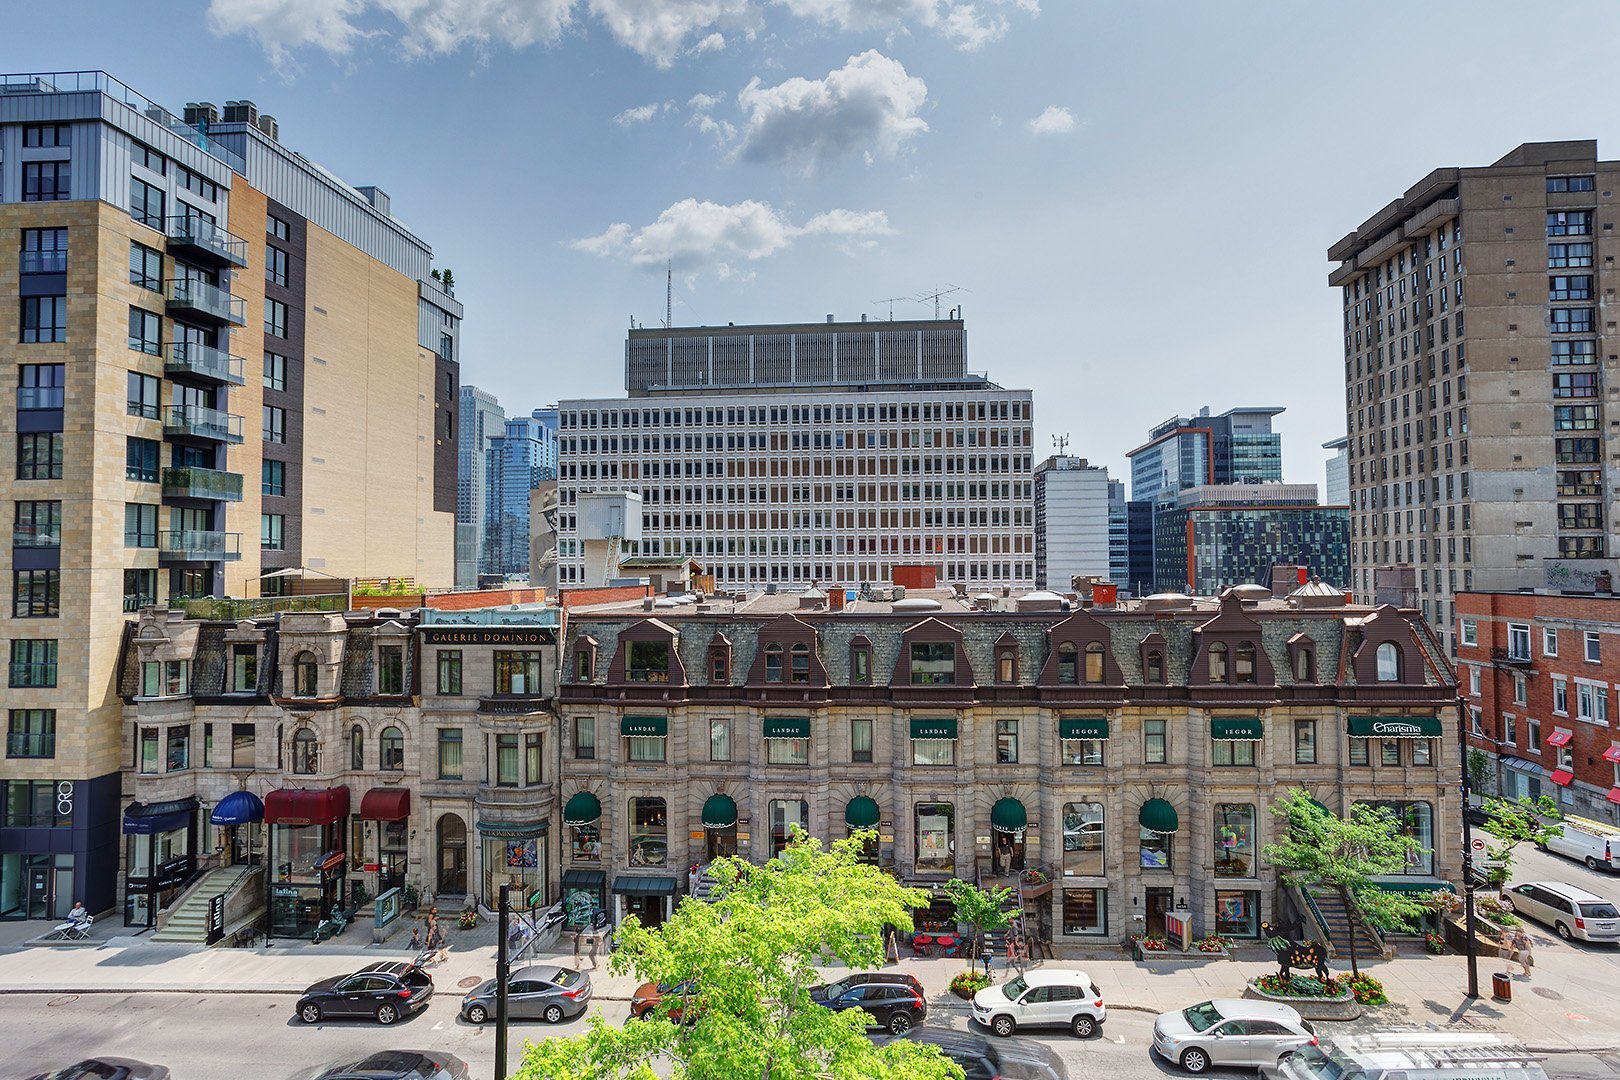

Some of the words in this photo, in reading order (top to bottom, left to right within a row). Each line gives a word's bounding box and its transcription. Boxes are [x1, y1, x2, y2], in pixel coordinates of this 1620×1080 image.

[432, 633, 478, 642] GALERIE
[484, 633, 547, 642] DOMINION
[1372, 721, 1421, 733] Charisma
